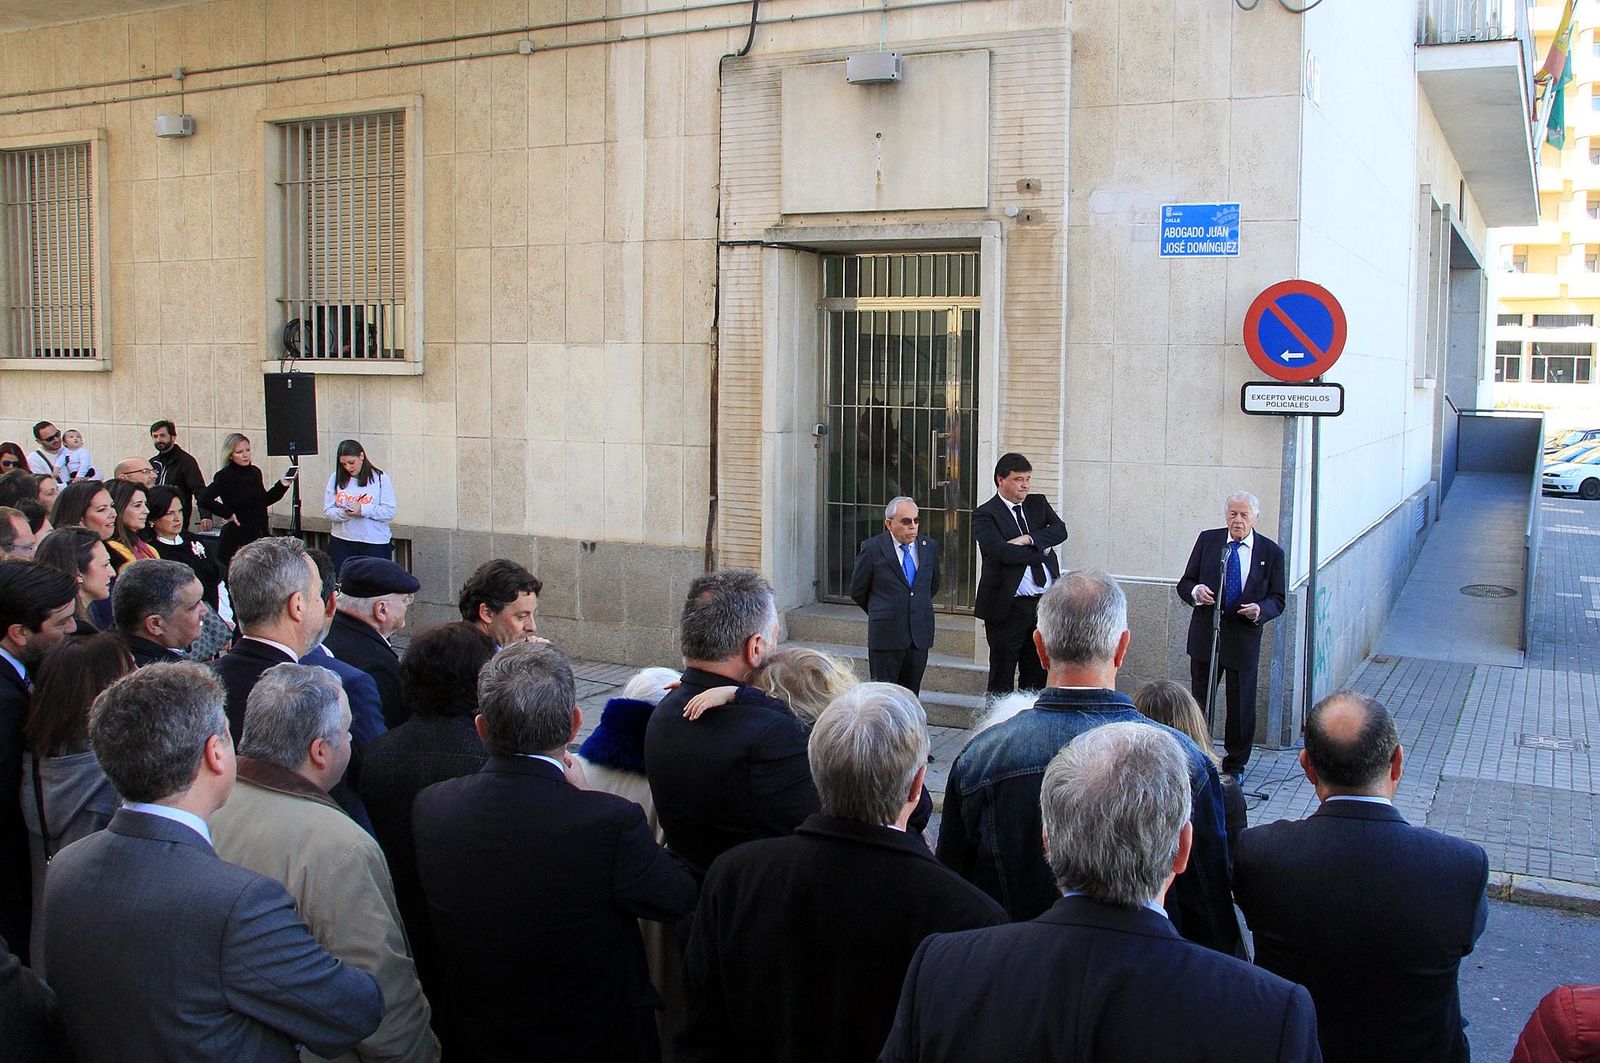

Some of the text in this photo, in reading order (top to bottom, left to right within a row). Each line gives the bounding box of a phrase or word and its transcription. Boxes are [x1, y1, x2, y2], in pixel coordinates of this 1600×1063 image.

[1164, 226, 1229, 238] ABOGADO JUAN
[1164, 240, 1237, 253] JOSÉ DOMÍNGUEZ
